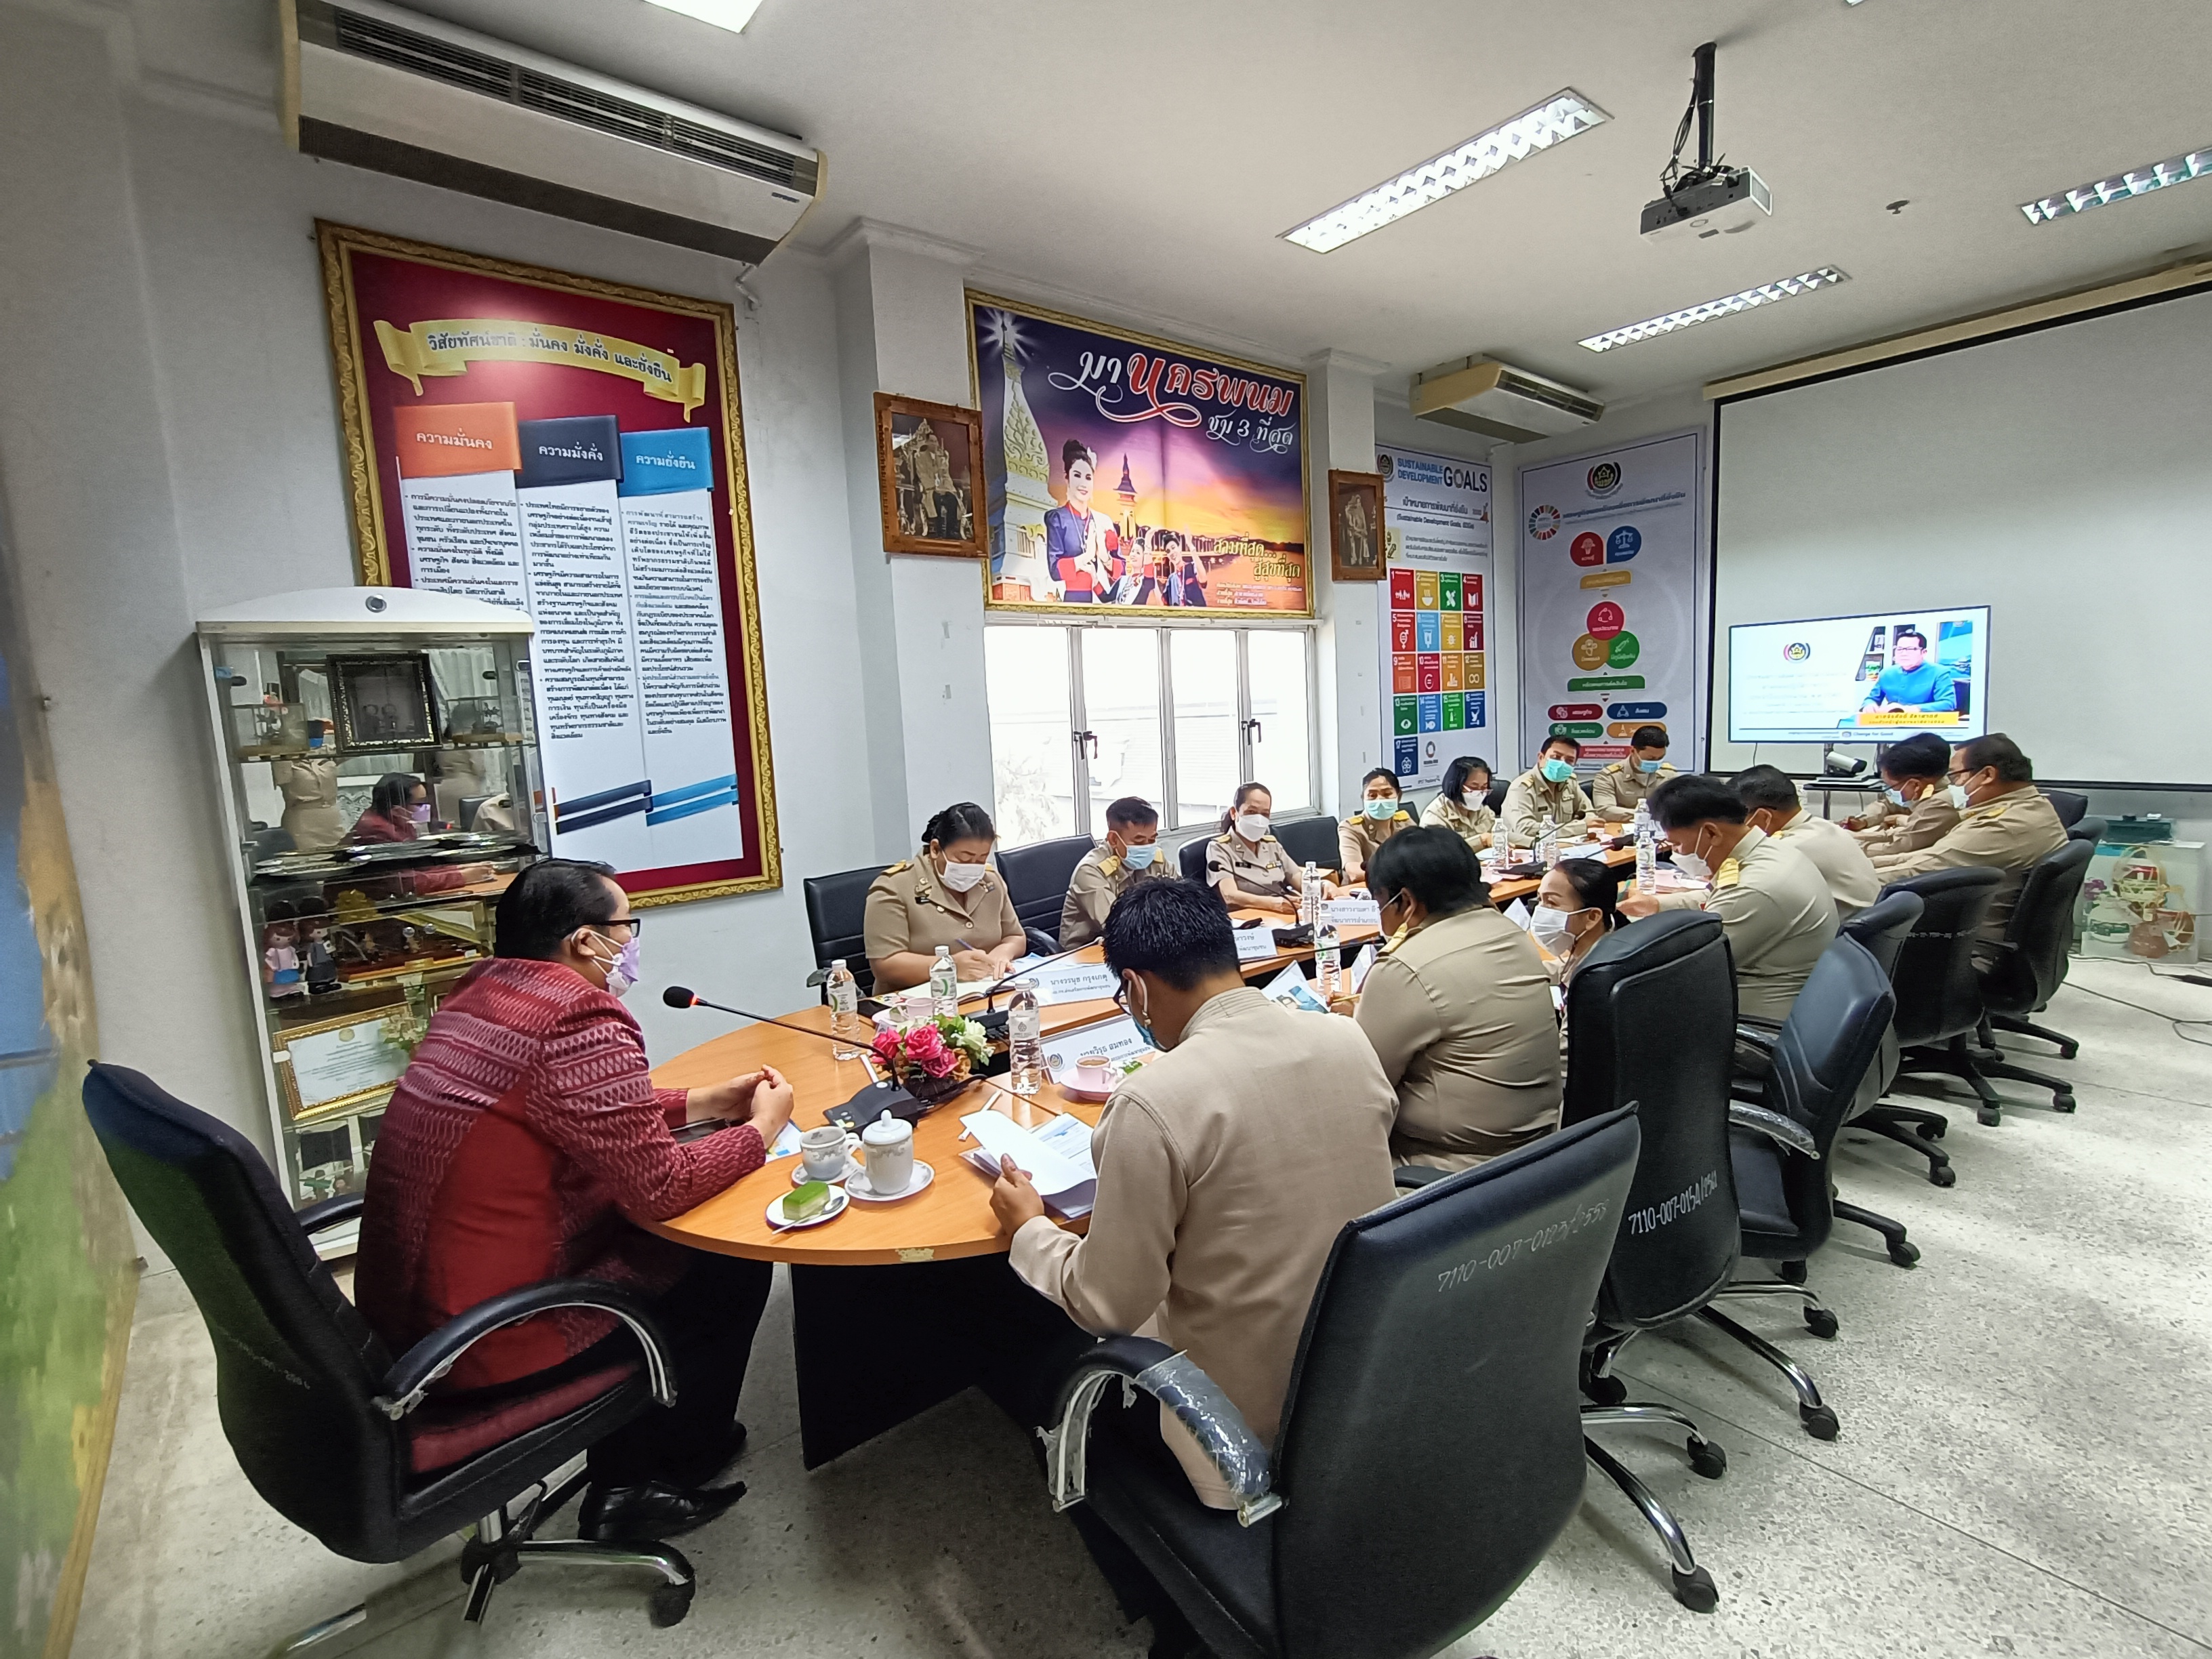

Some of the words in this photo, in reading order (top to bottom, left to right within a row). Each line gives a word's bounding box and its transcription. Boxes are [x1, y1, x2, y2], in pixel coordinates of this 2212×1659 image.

[529, 328, 568, 352] มั่นคง
[574, 333, 609, 361] มั่งคั่ง
[615, 353, 672, 383] และยั่งยืน
[1095, 352, 1294, 428] นครพนม
[416, 428, 493, 450] ความมั่นคง
[1237, 419, 1250, 437] 3
[1250, 415, 1296, 454] ที่สุด
[539, 441, 603, 462] ความมั่งคั่ง
[636, 450, 695, 470] ความยั่งยืน
[1397, 457, 1443, 474] SUSTAINABLE
[1443, 466, 1488, 492] GOALS
[1397, 469, 1443, 485] DEVELOPMENT
[1391, 571, 1394, 579] 1
[1416, 573, 1420, 581] 2
[1440, 574, 1444, 582] 3
[1393, 614, 1397, 622] 5
[1393, 657, 1397, 665] 9
[1419, 656, 1424, 665] 10
[1396, 741, 1401, 749] 17
